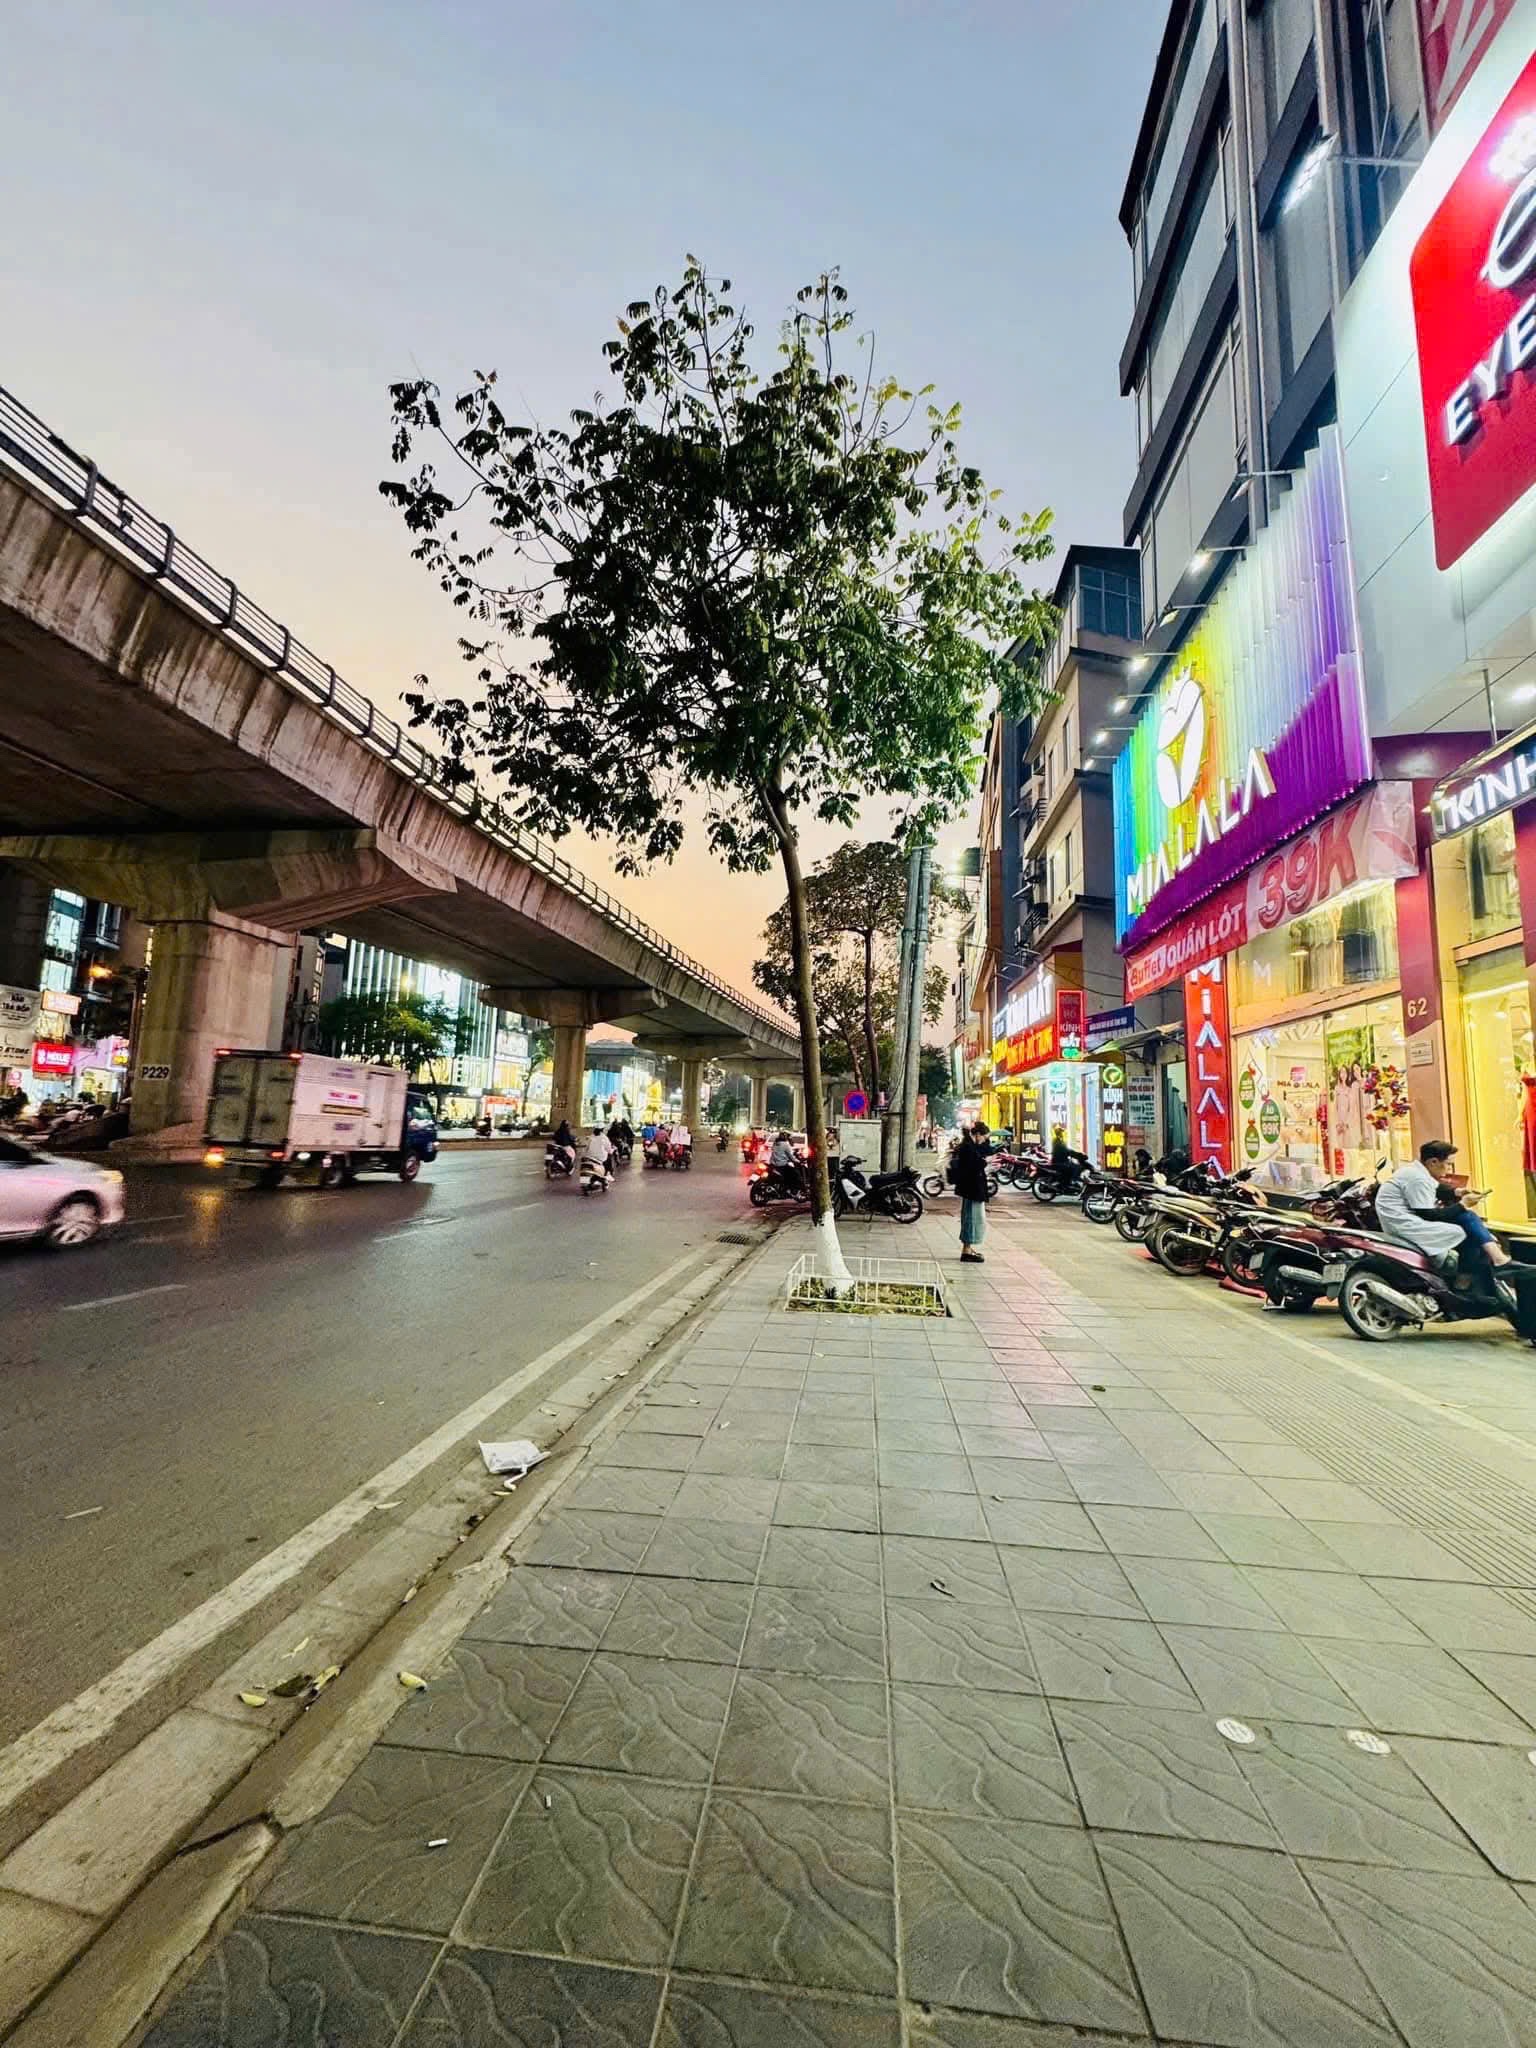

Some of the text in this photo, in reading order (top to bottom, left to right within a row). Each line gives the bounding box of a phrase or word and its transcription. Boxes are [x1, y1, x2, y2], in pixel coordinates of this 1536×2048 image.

[1208, 903, 1243, 945] LÓT
[1258, 800, 1361, 930] 39K
[1407, 997, 1428, 1018] 62
[142, 1066, 169, 1079] P229
